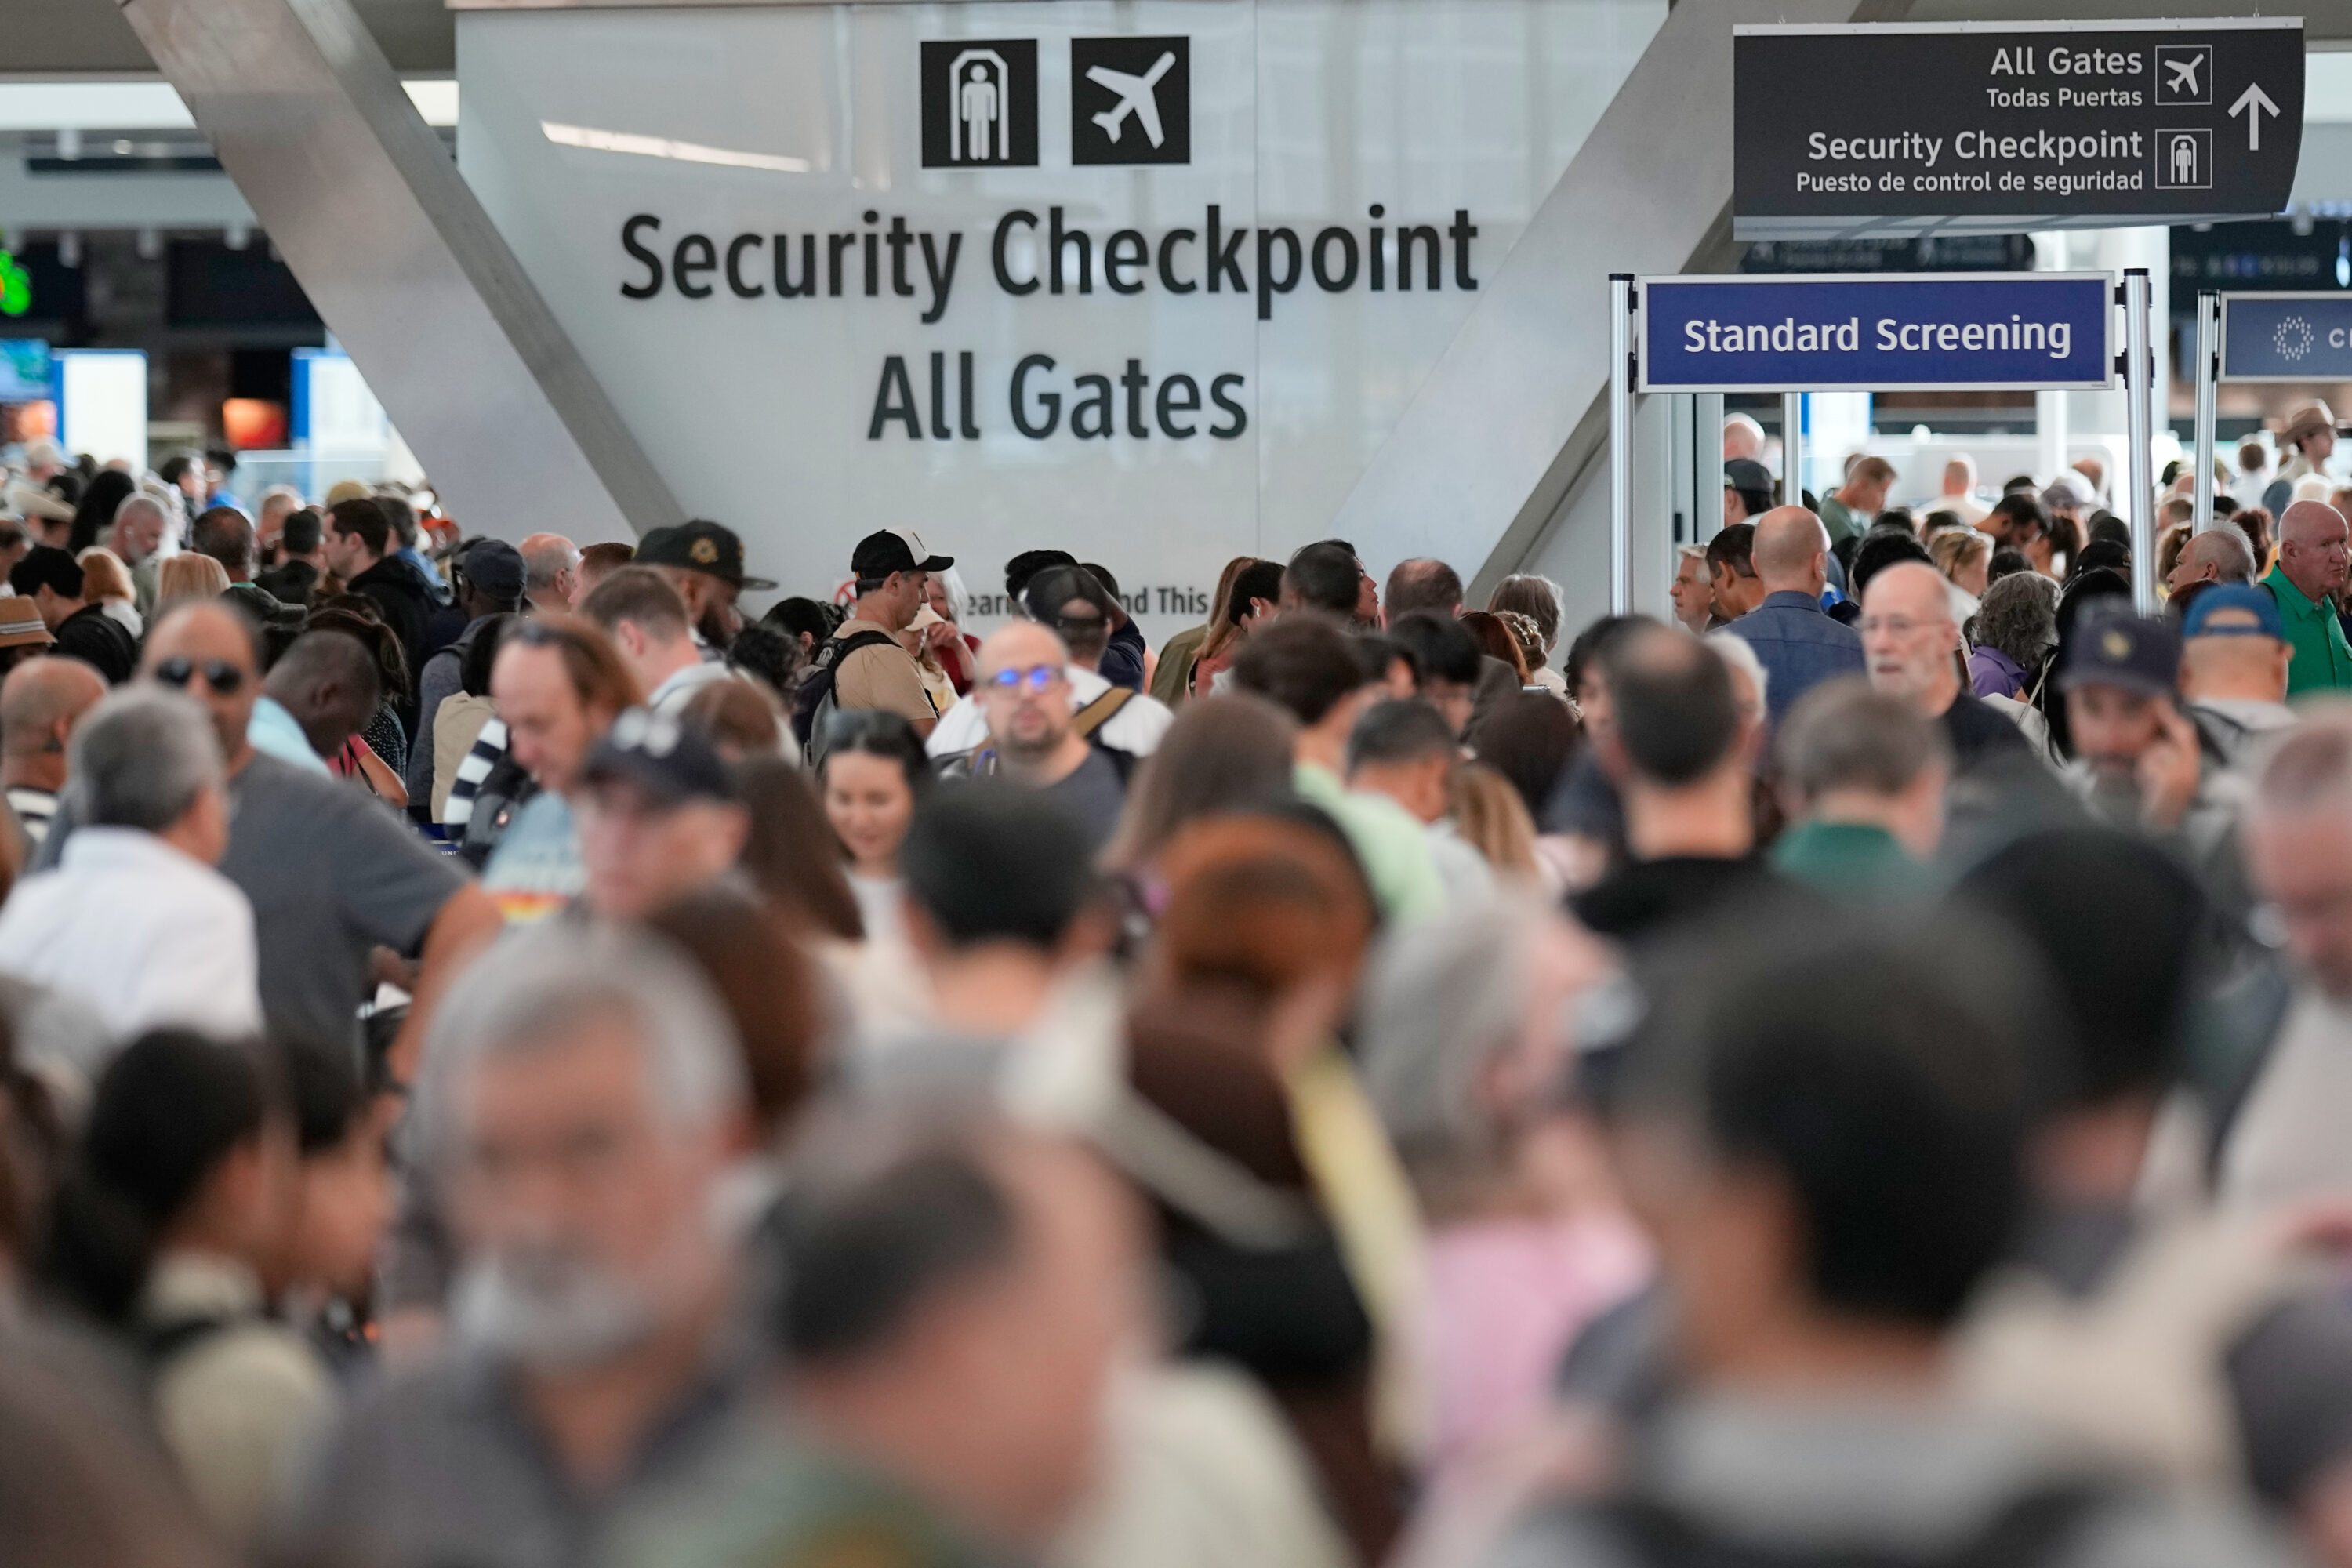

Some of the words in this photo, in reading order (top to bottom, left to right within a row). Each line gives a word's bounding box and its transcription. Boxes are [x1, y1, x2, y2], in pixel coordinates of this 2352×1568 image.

[1991, 47, 2036, 75] All
[2049, 47, 2143, 74] Gates
[1986, 88, 2050, 107] Todas
[2058, 88, 2143, 107] Puertas
[1809, 131, 1943, 167] Security
[1955, 130, 2143, 166] Checkpoint
[1797, 172, 1871, 192] Puesto
[1878, 172, 1905, 191] de
[1913, 172, 1991, 191] control
[1998, 172, 2026, 191] de
[2033, 171, 2143, 195] seguridad
[620, 209, 964, 325] Security
[991, 203, 1479, 321] Checkpoint
[1683, 317, 1859, 353] Standard
[1875, 314, 2071, 359] Screening
[867, 350, 981, 441] All
[1009, 354, 1247, 440] Gates
[1156, 586, 1208, 615] This
